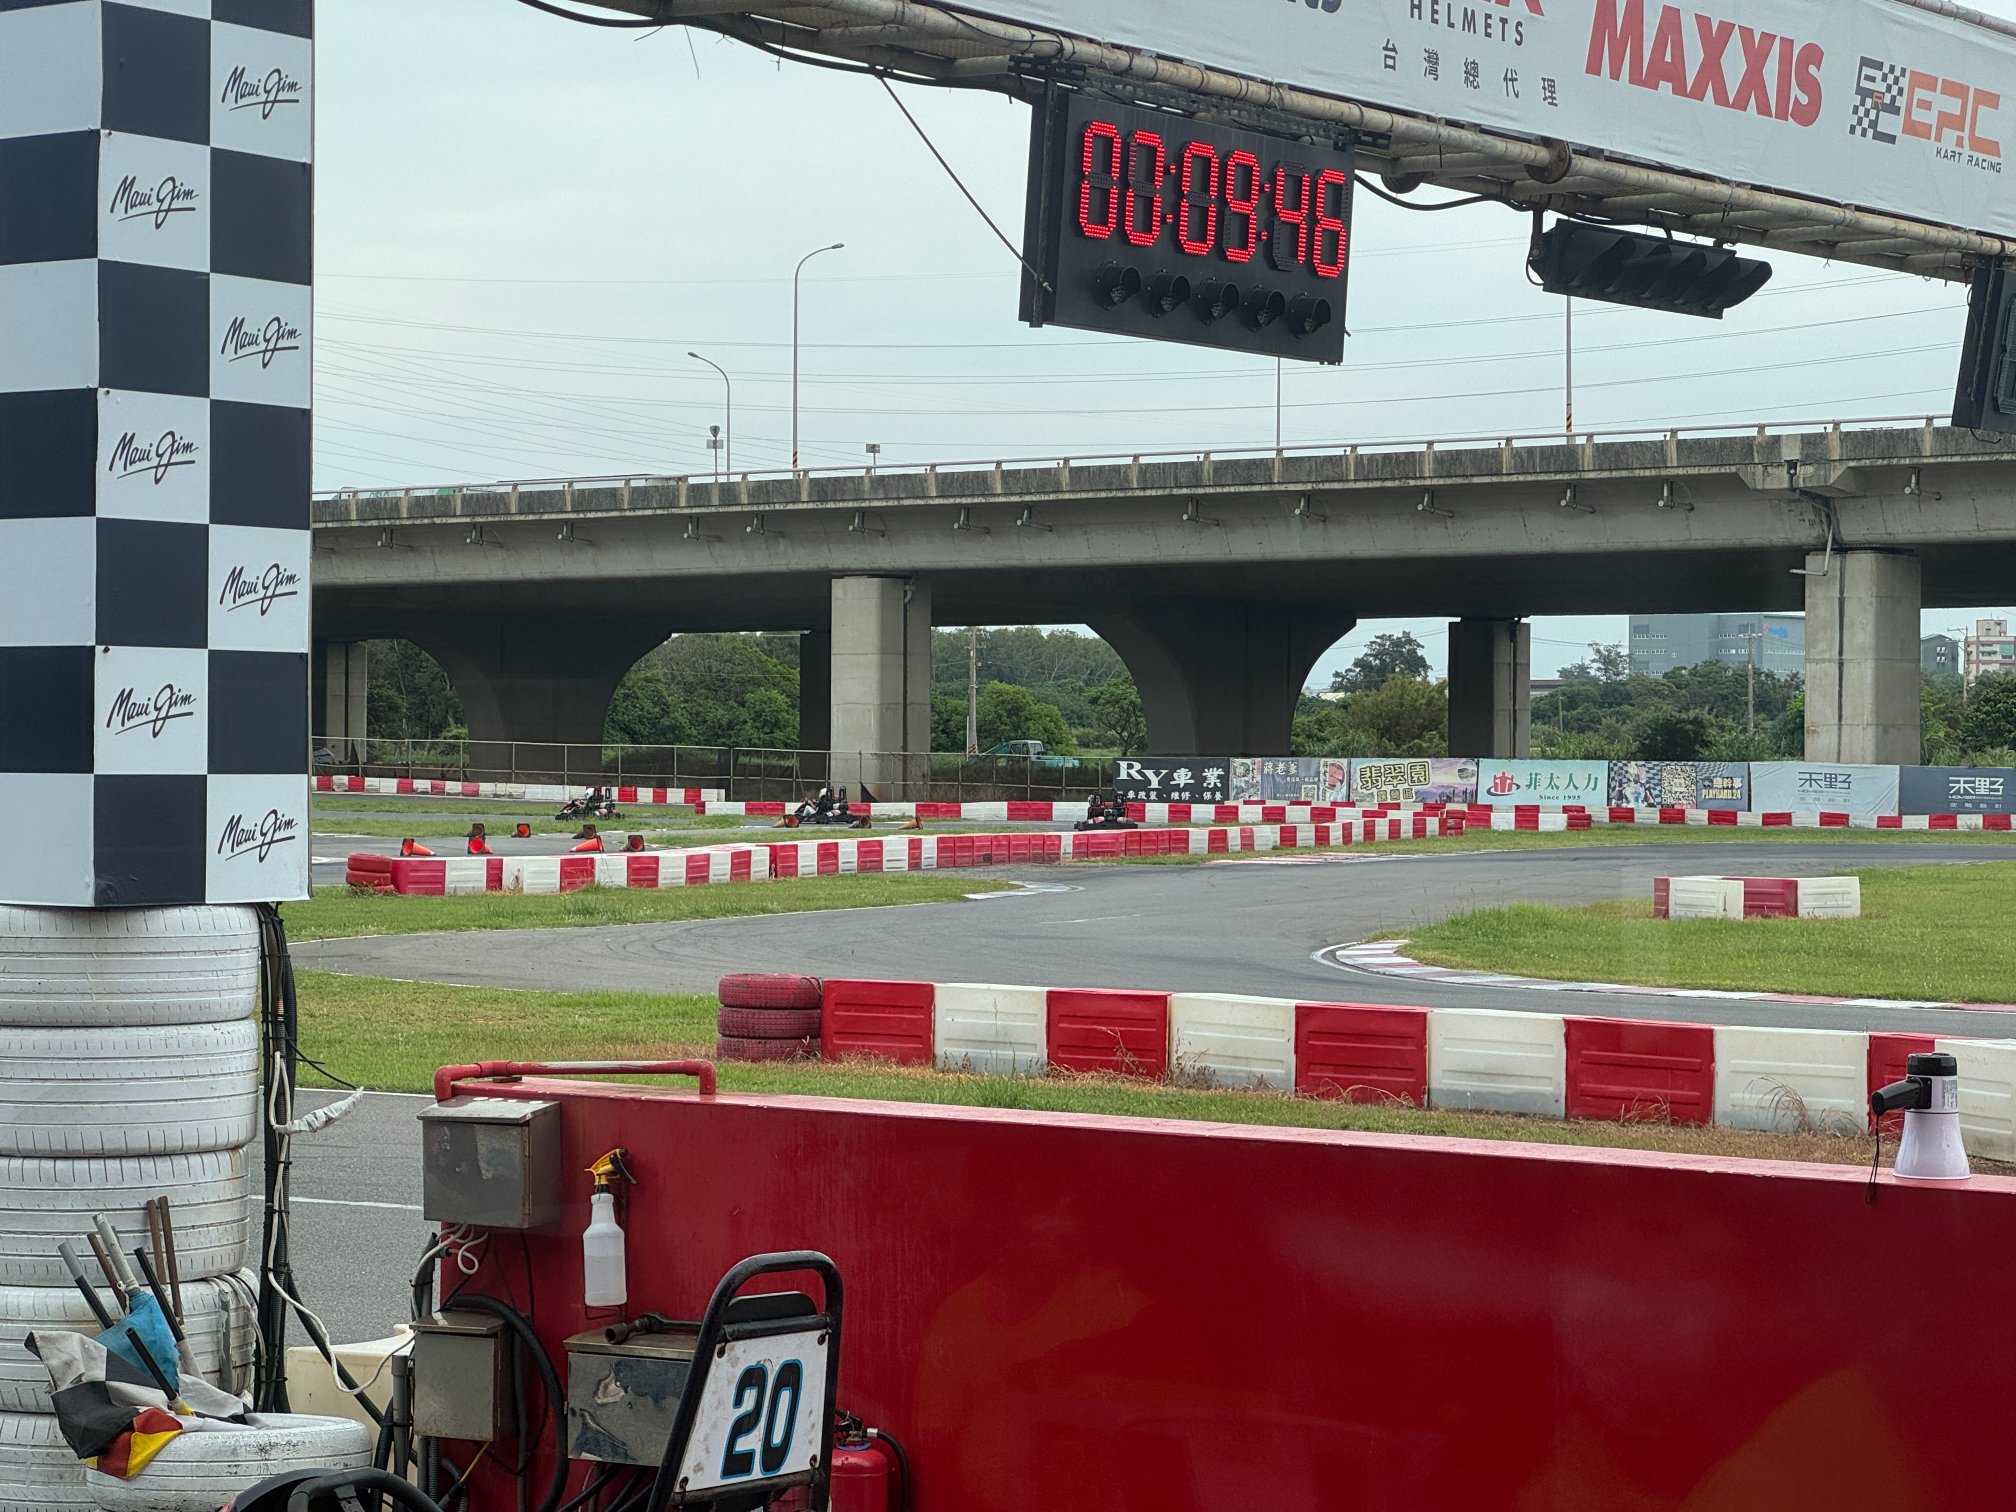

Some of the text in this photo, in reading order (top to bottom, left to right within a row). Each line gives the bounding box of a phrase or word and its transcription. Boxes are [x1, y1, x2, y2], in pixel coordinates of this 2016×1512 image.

[1410, 0, 1524, 46] HELMETS
[1382, 38, 1558, 107] 台灣總代理
[1585, 0, 1823, 127] MAXXIS
[222, 66, 302, 120] Maui Jim
[1935, 146, 2002, 174] KART RACING
[110, 176, 198, 230] Maui Jim
[1079, 120, 1347, 278] 00:09:46
[221, 317, 301, 369] Maui Jim
[109, 432, 198, 485] Maui Jim
[220, 564, 300, 616] Maui Jim
[106, 684, 196, 738] Maui Jim
[1359, 761, 1430, 790] 翡翠園
[1525, 772, 1599, 792] 菲太人力
[1798, 771, 1852, 790] 禾野
[1948, 776, 2004, 795] 禾野
[218, 810, 298, 863] Maui Jim
[719, 1358, 804, 1480] 20
